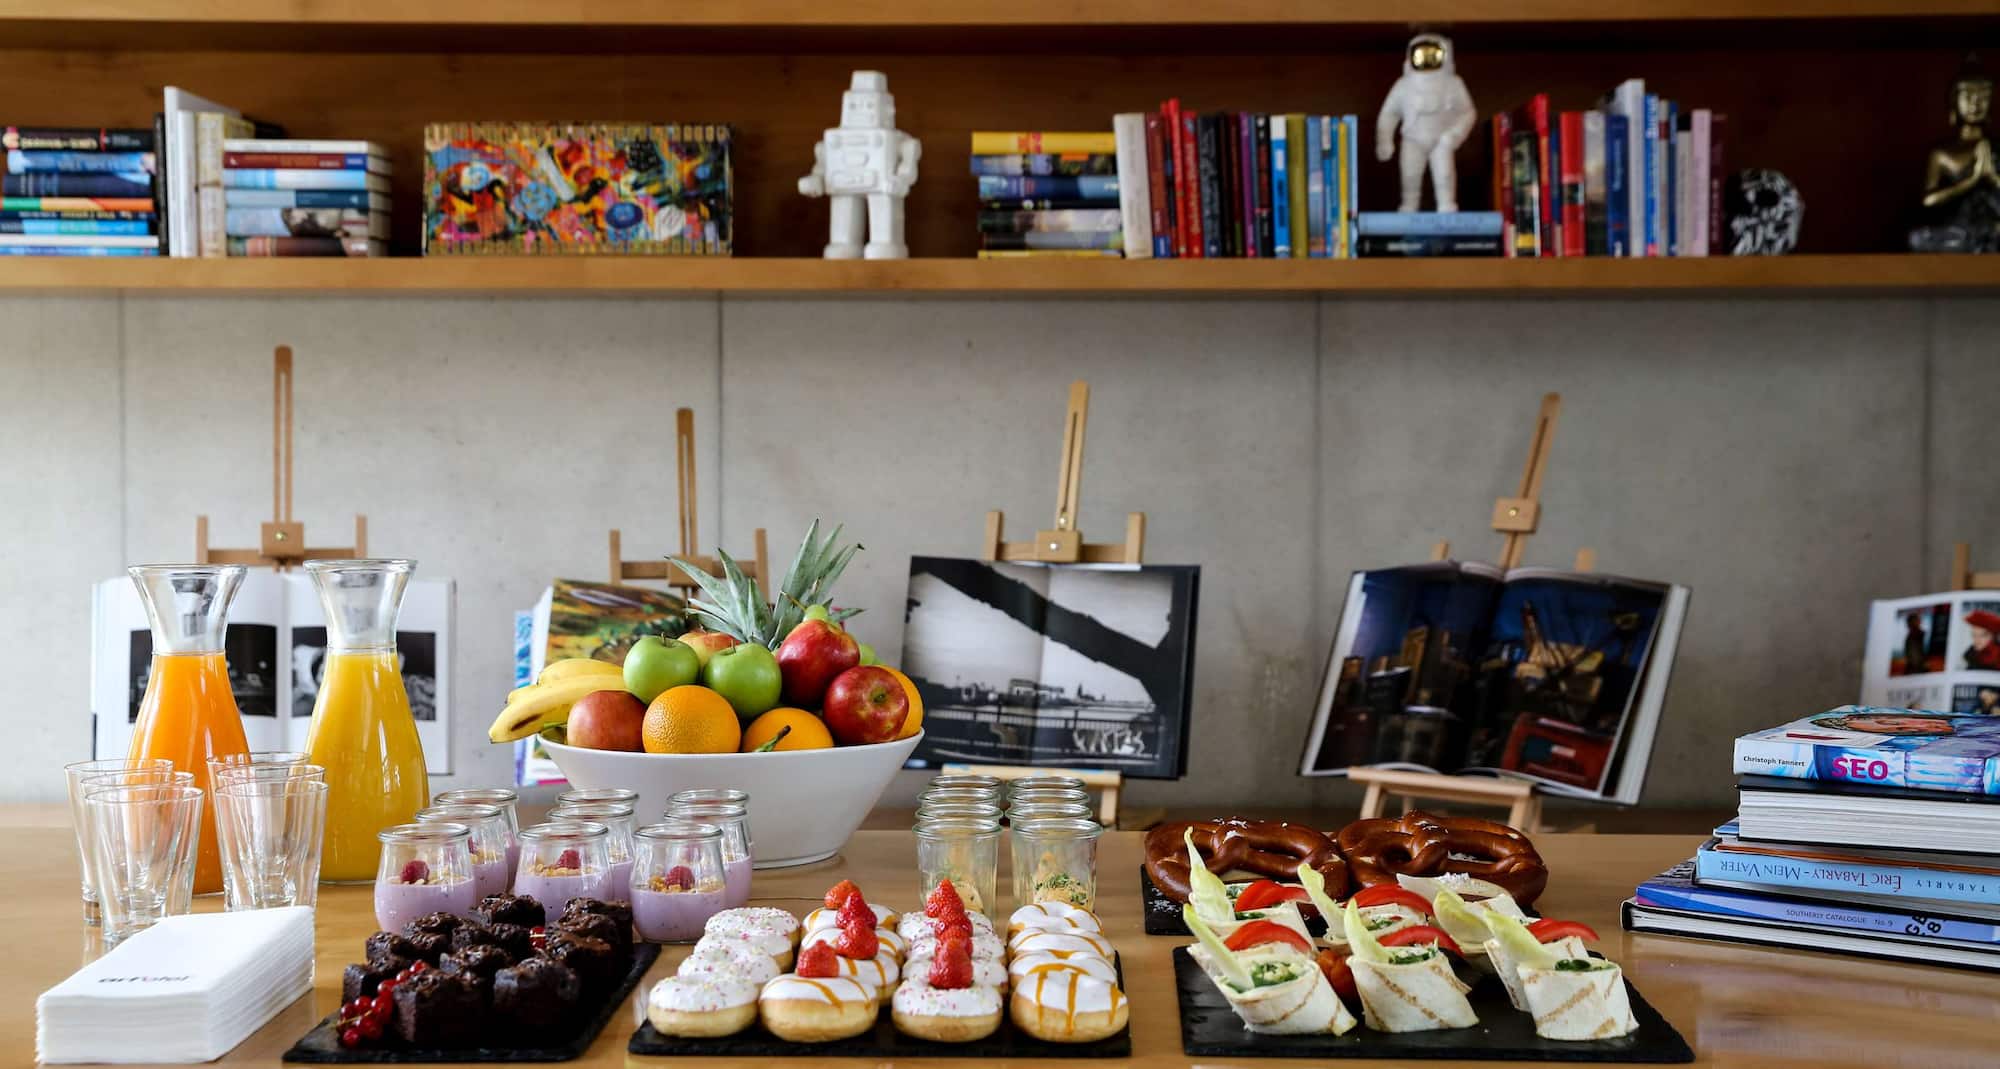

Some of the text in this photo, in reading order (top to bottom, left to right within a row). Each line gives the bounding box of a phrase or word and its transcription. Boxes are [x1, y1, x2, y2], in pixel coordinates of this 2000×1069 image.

[1743, 755, 1805, 767] Christoph Tannert
[1831, 756, 1889, 781] SEO
[1720, 860, 1760, 877] VATER
[1763, 862, 1801, 880] MEIN
[1813, 869, 1869, 887] TABARLY
[1915, 879, 1987, 893] TABARLY
[1826, 911, 1867, 924] CATALOGUE
